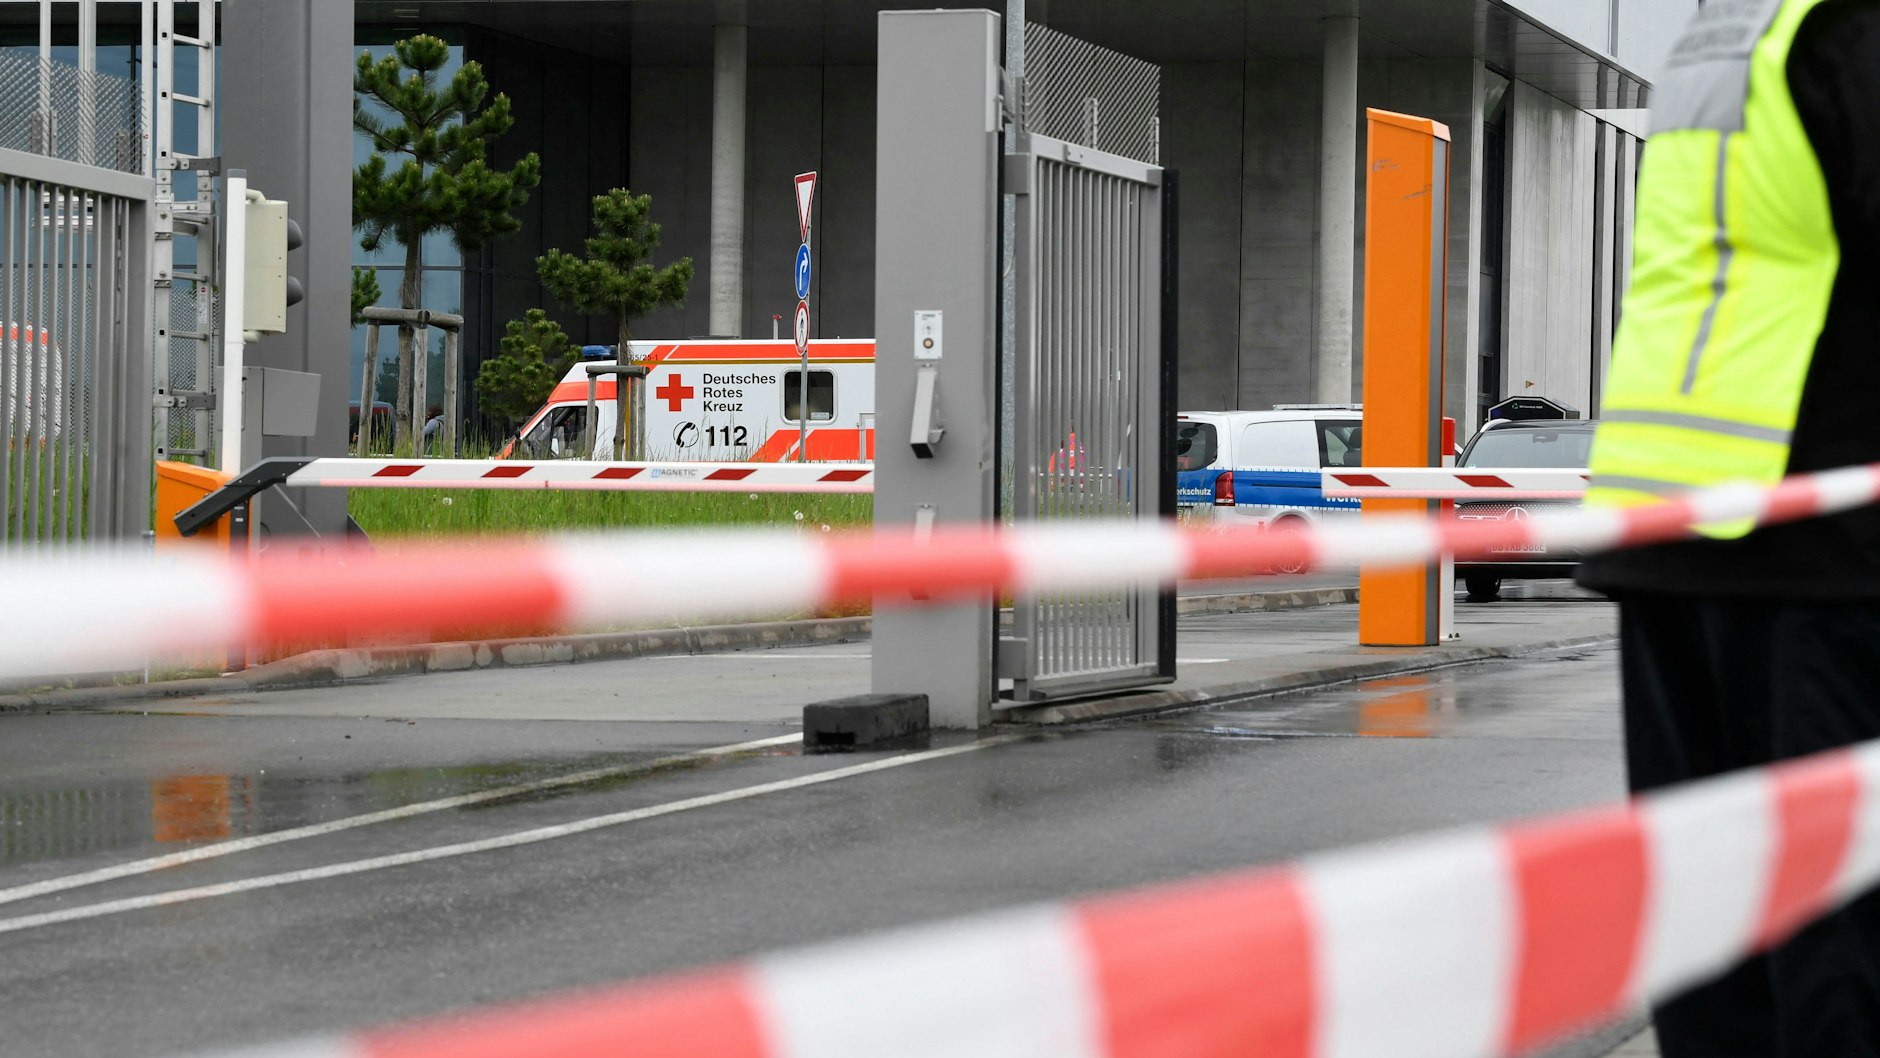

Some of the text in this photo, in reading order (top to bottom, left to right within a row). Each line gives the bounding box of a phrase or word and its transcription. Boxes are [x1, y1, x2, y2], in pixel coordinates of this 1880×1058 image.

[703, 373, 776, 384] Deutsches
[703, 387, 743, 398] Rotes
[703, 401, 743, 412] Kreuz
[705, 425, 748, 446] 112
[1177, 487, 1212, 496] erkschutz
